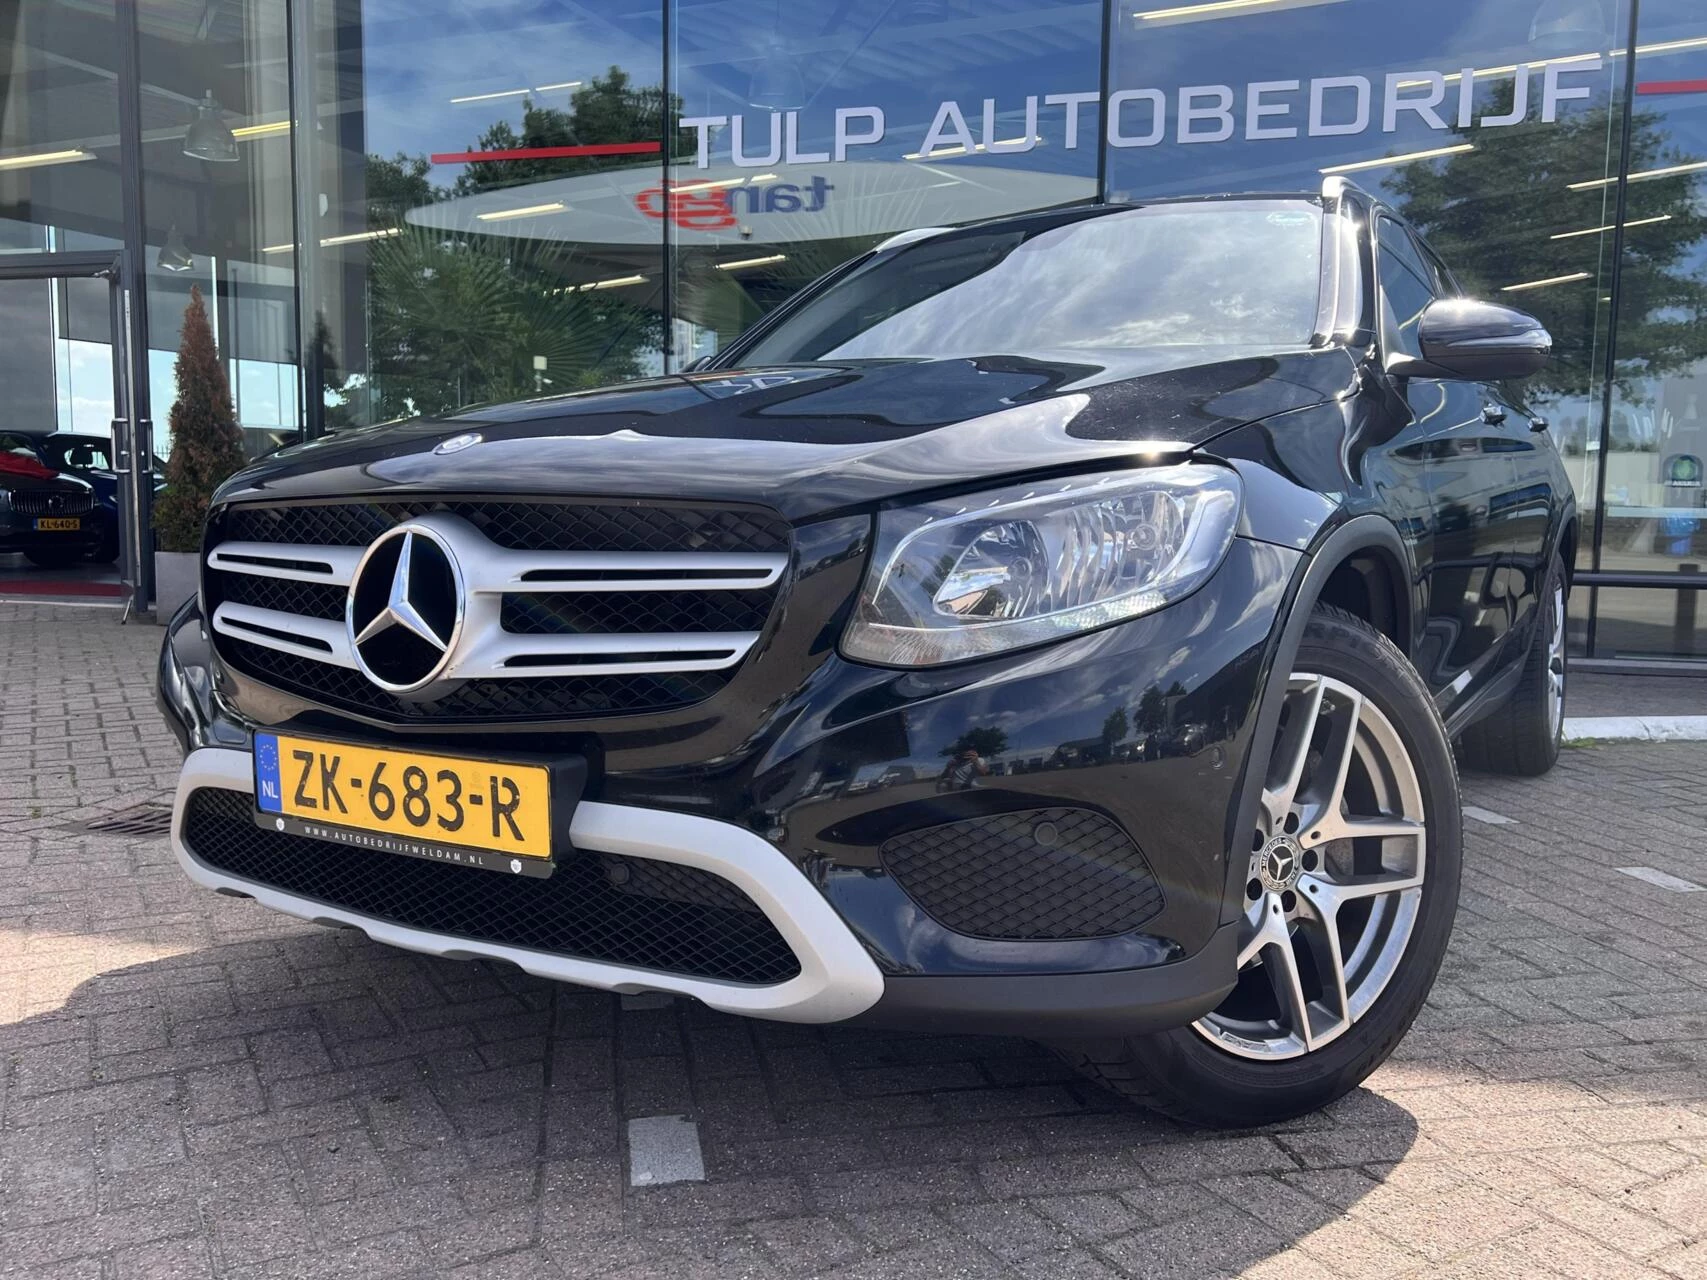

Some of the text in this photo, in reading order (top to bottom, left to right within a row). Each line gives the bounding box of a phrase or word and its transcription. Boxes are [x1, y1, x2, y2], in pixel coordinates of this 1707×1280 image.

[678, 60, 1602, 169] TULP AUTOBEDRIJF
[262, 780, 279, 799] NL
[292, 750, 525, 842] ZK-683-R
[304, 826, 484, 865] WWW.AUTOBEDRIJFWELDAM.NL
